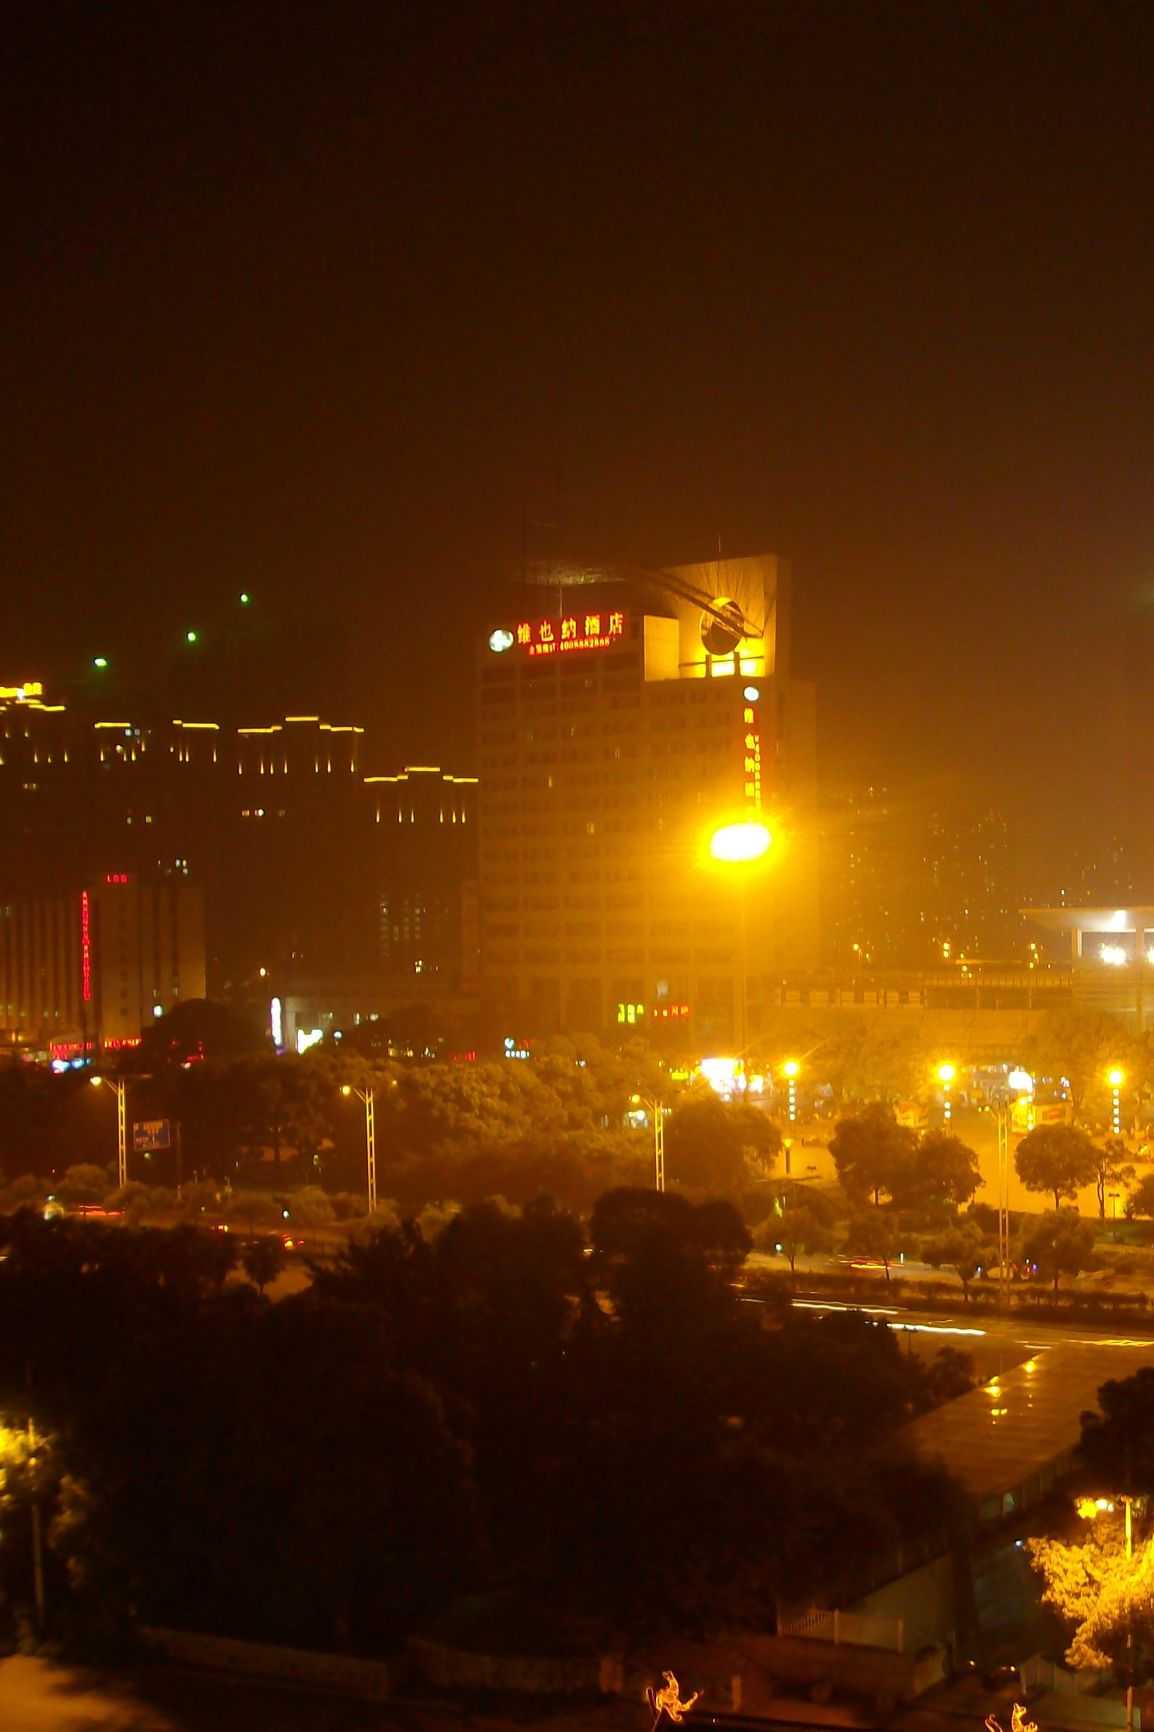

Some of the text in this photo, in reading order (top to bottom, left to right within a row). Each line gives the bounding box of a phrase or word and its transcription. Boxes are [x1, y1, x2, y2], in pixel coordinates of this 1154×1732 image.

[517, 612, 624, 644] 维也纳酒店
